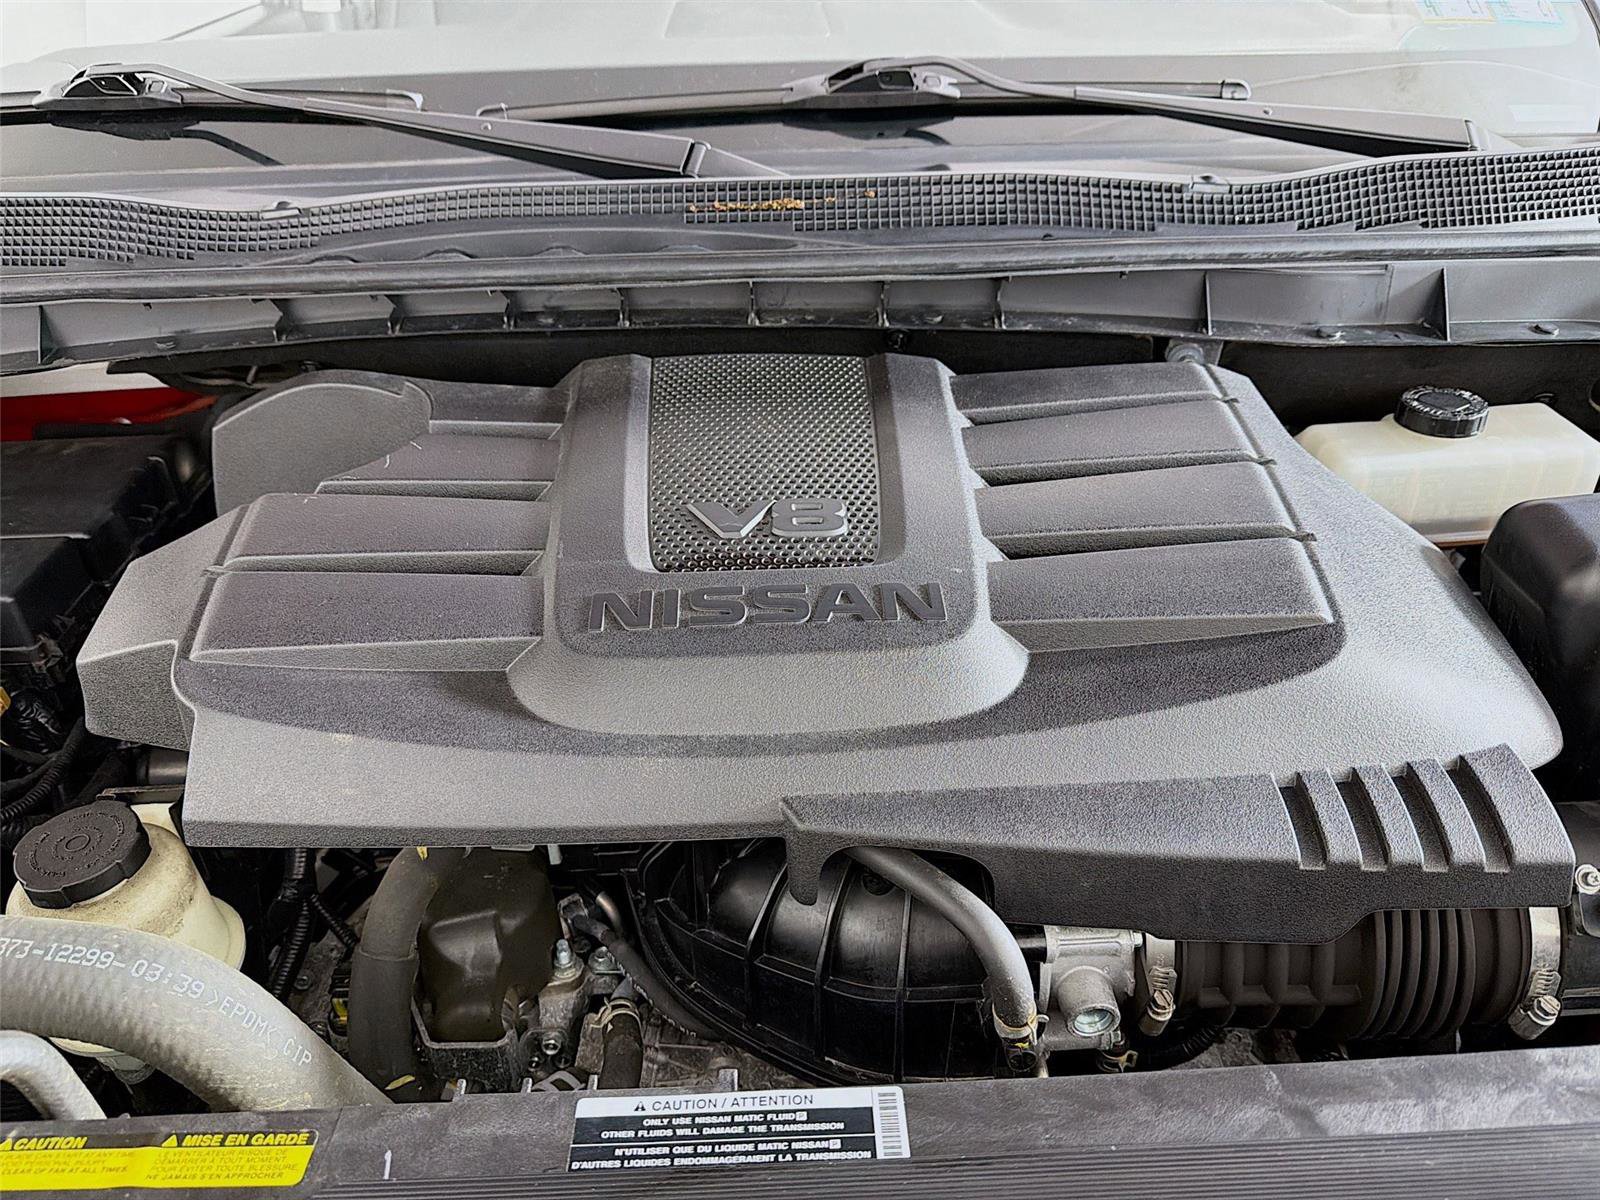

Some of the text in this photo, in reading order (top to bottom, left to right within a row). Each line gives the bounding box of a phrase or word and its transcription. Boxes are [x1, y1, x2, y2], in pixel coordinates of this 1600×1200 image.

[687, 499, 848, 539] V8
[587, 582, 948, 633] NISSAN
[282, 1036, 312, 1066] CIP
[652, 1098, 717, 1112] CAUTION
[731, 1094, 814, 1108] ATTENTION
[643, 1118, 670, 1127] ONLY
[672, 1117, 692, 1126] USE
[695, 1115, 731, 1124] NISSAN
[734, 1113, 765, 1123] MATIC
[767, 1112, 795, 1121] FLUID
[601, 1122, 845, 1139] OTHER FLUIDS WILL DAMAGE THE TRANSMISSION
[13, 1136, 88, 1150] CAUTION
[181, 1132, 310, 1147] MISE EN GARDE
[672, 1145, 694, 1155] QUE
[696, 1144, 712, 1153] DU
[714, 1142, 755, 1153] LIQUIDE
[757, 1141, 789, 1151] MATIC
[791, 1140, 829, 1150] NISSAN
[571, 1159, 621, 1170] D'AUTRES
[624, 1157, 671, 1168] LIQUIDES
[778, 1153, 794, 1162] LA
[795, 1150, 872, 1162] TRANSMISSION
